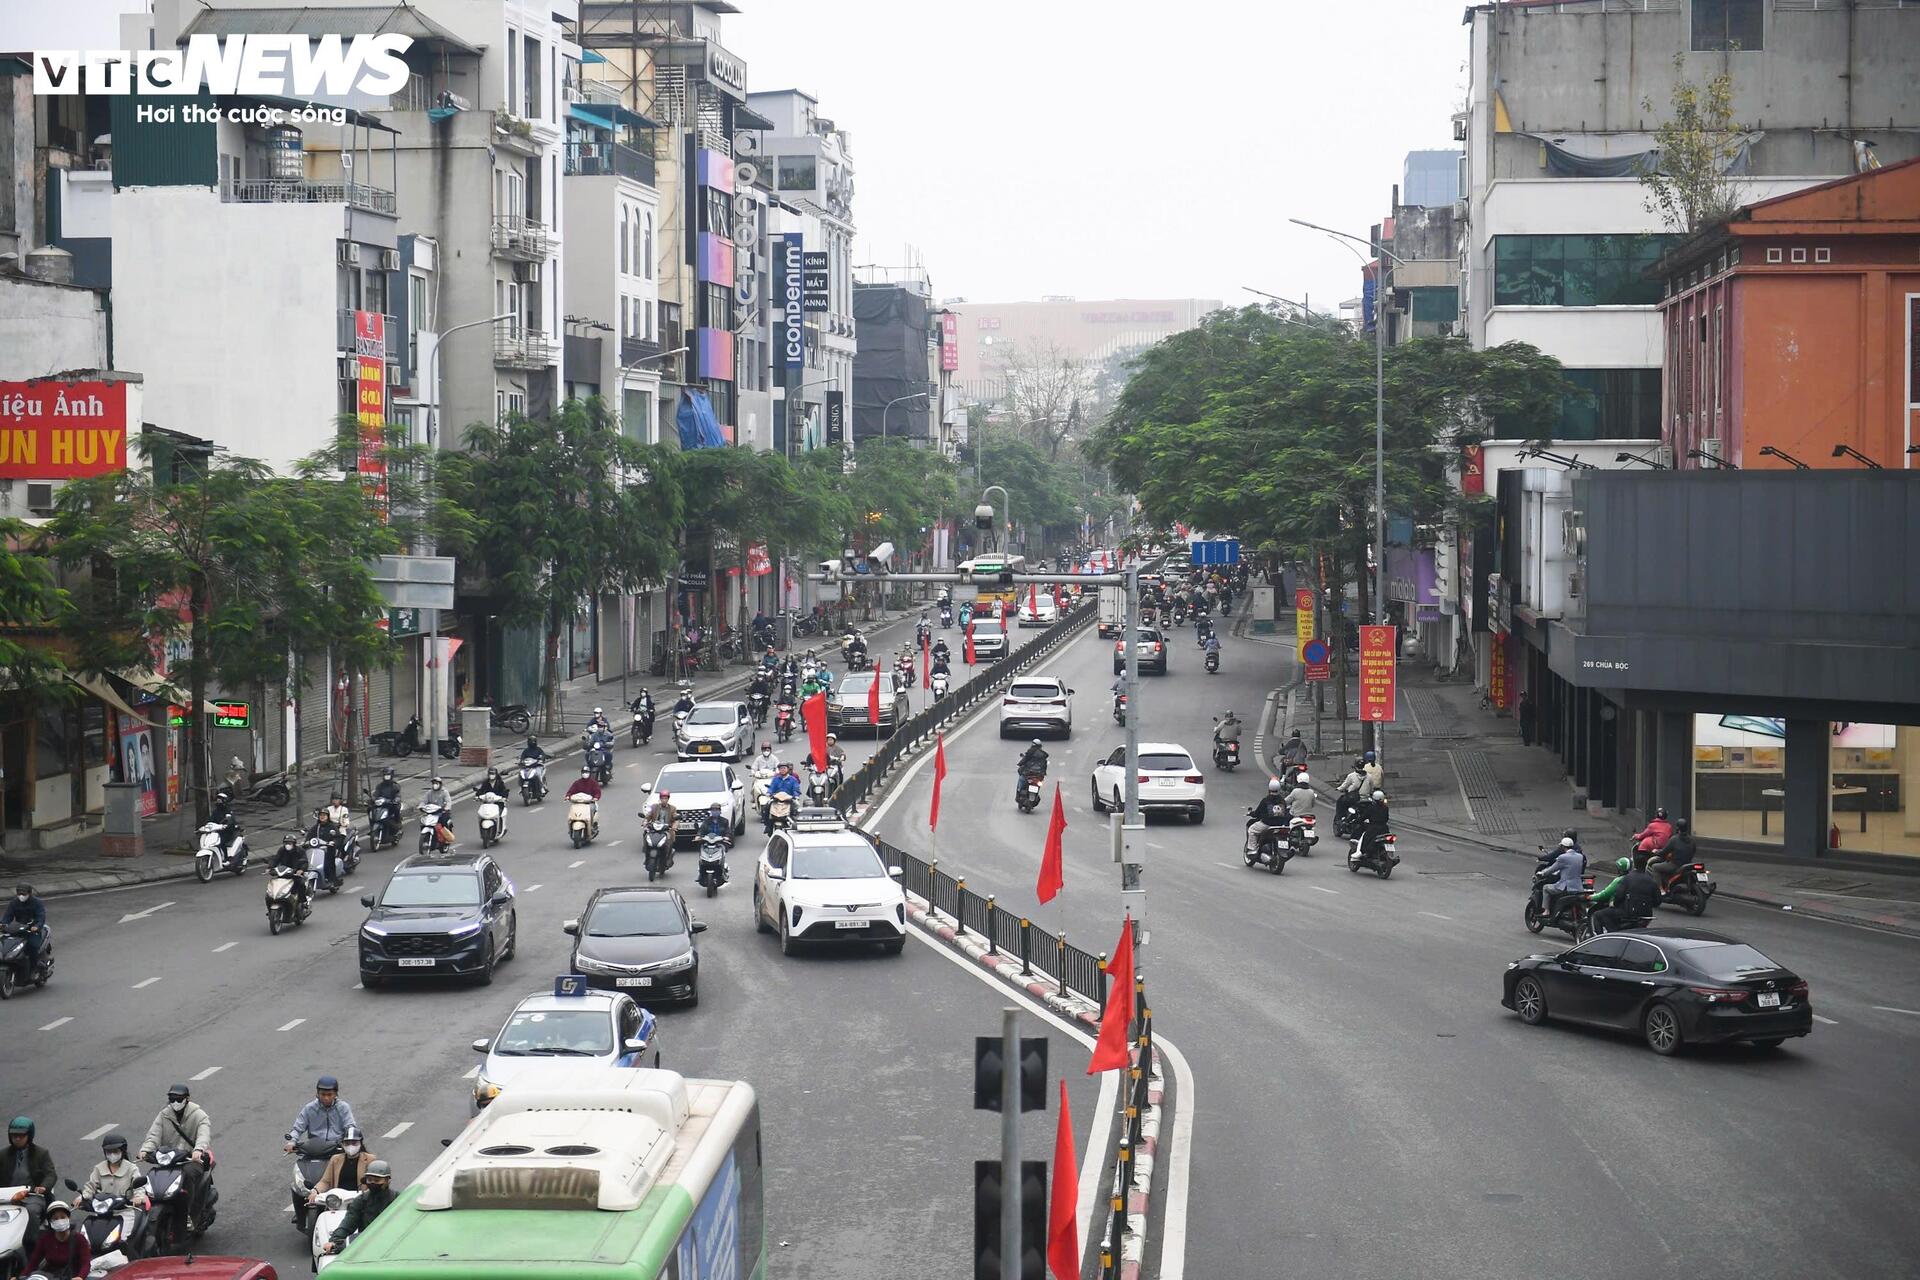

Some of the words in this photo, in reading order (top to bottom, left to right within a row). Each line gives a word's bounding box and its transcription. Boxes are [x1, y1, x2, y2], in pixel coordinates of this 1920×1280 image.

[714, 52, 744, 91] COCOLUX
[732, 131, 759, 336] COCOLUX
[805, 256, 826, 266] KÍNH
[804, 299, 827, 307] ANNA
[0, 393, 42, 421] iệu
[53, 390, 104, 416] Ảnh
[831, 403, 840, 432] DESIGN
[51, 429, 121, 465] HUY
[1583, 660, 1594, 668] 269
[1595, 659, 1613, 669] CHÙA
[562, 978, 578, 994] G7
